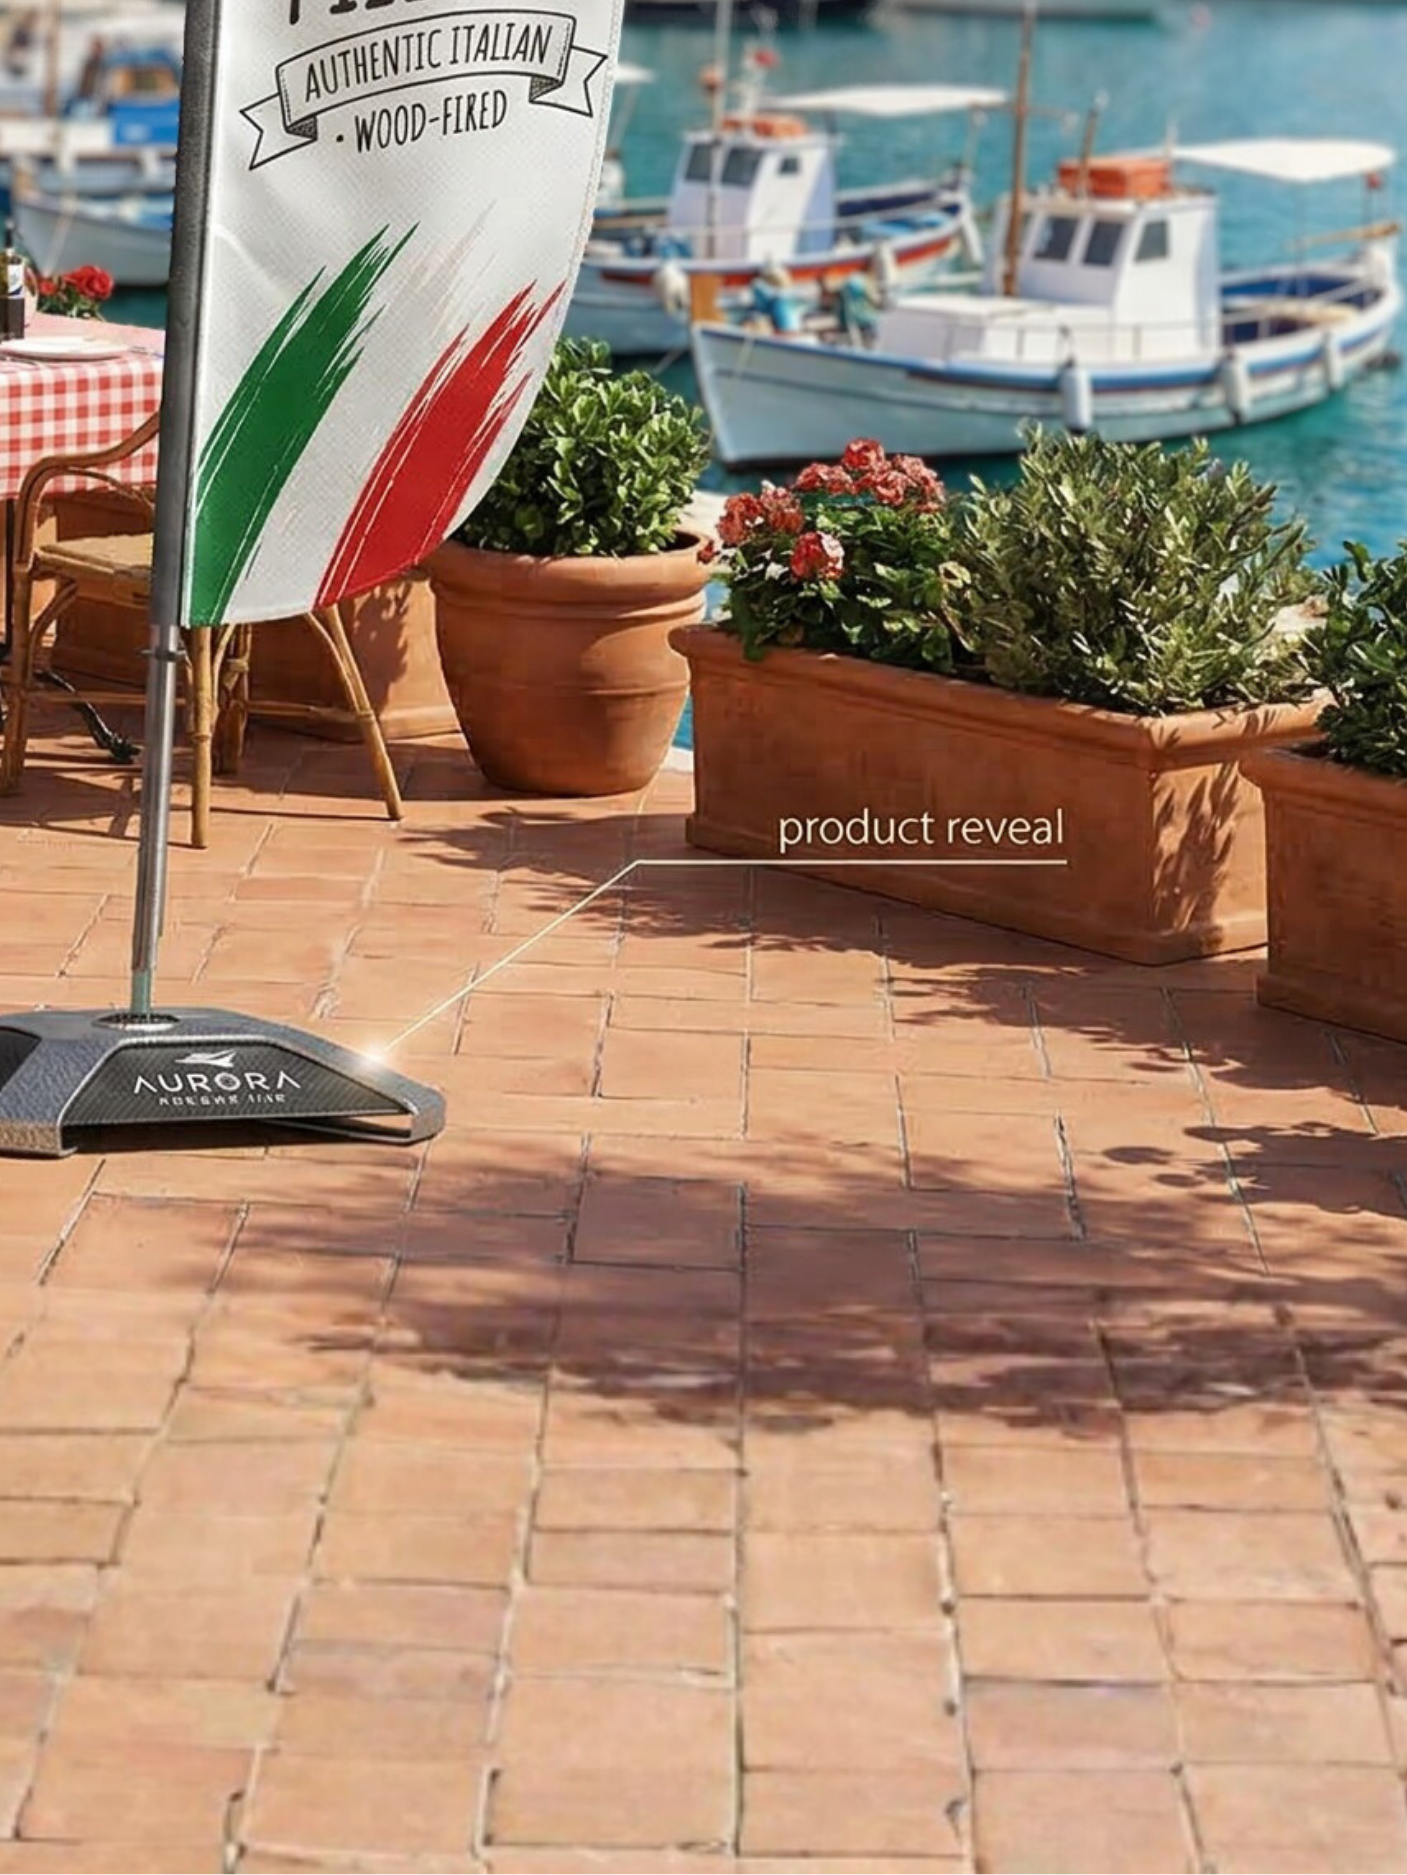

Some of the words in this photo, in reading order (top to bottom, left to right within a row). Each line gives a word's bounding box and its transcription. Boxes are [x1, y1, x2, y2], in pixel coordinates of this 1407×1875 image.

[305, 28, 442, 102] AUTHENTIC
[449, 22, 553, 66] ITALIAN
[354, 89, 507, 154] WOOD-FIRED
[133, 1070, 301, 1095] AURORA
